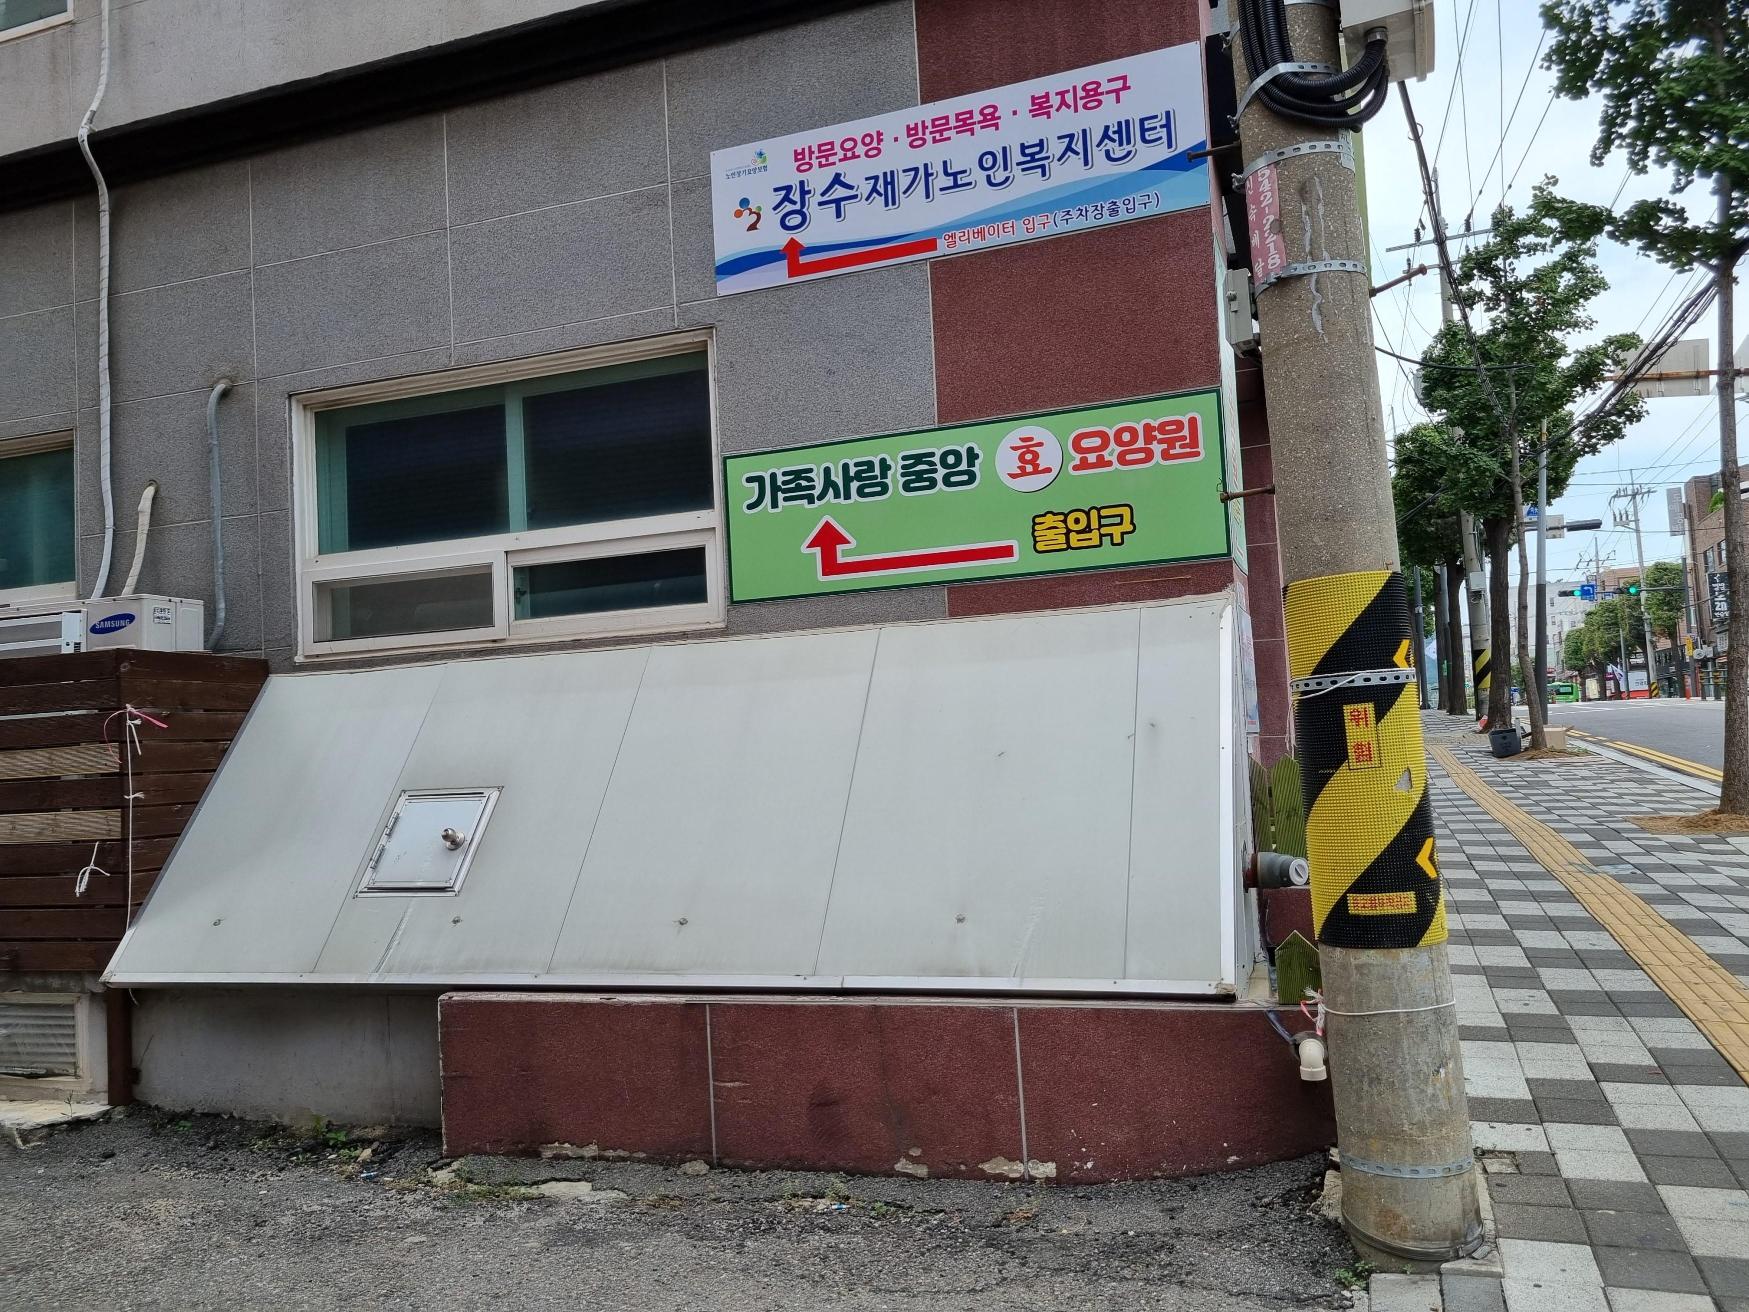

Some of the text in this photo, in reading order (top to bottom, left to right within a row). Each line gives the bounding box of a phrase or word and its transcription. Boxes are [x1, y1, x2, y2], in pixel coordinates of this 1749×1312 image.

[793, 74, 1131, 174] 방문요양 방문목욕 복지용구
[771, 108, 1178, 233] 장수재가노인복지센터
[943, 221, 1016, 249] 엘리베이터
[743, 415, 1202, 513] 가족사랑 중앙 효 요양원
[1032, 503, 1136, 554] 출입구
[95, 618, 131, 629] SAMSUNG
